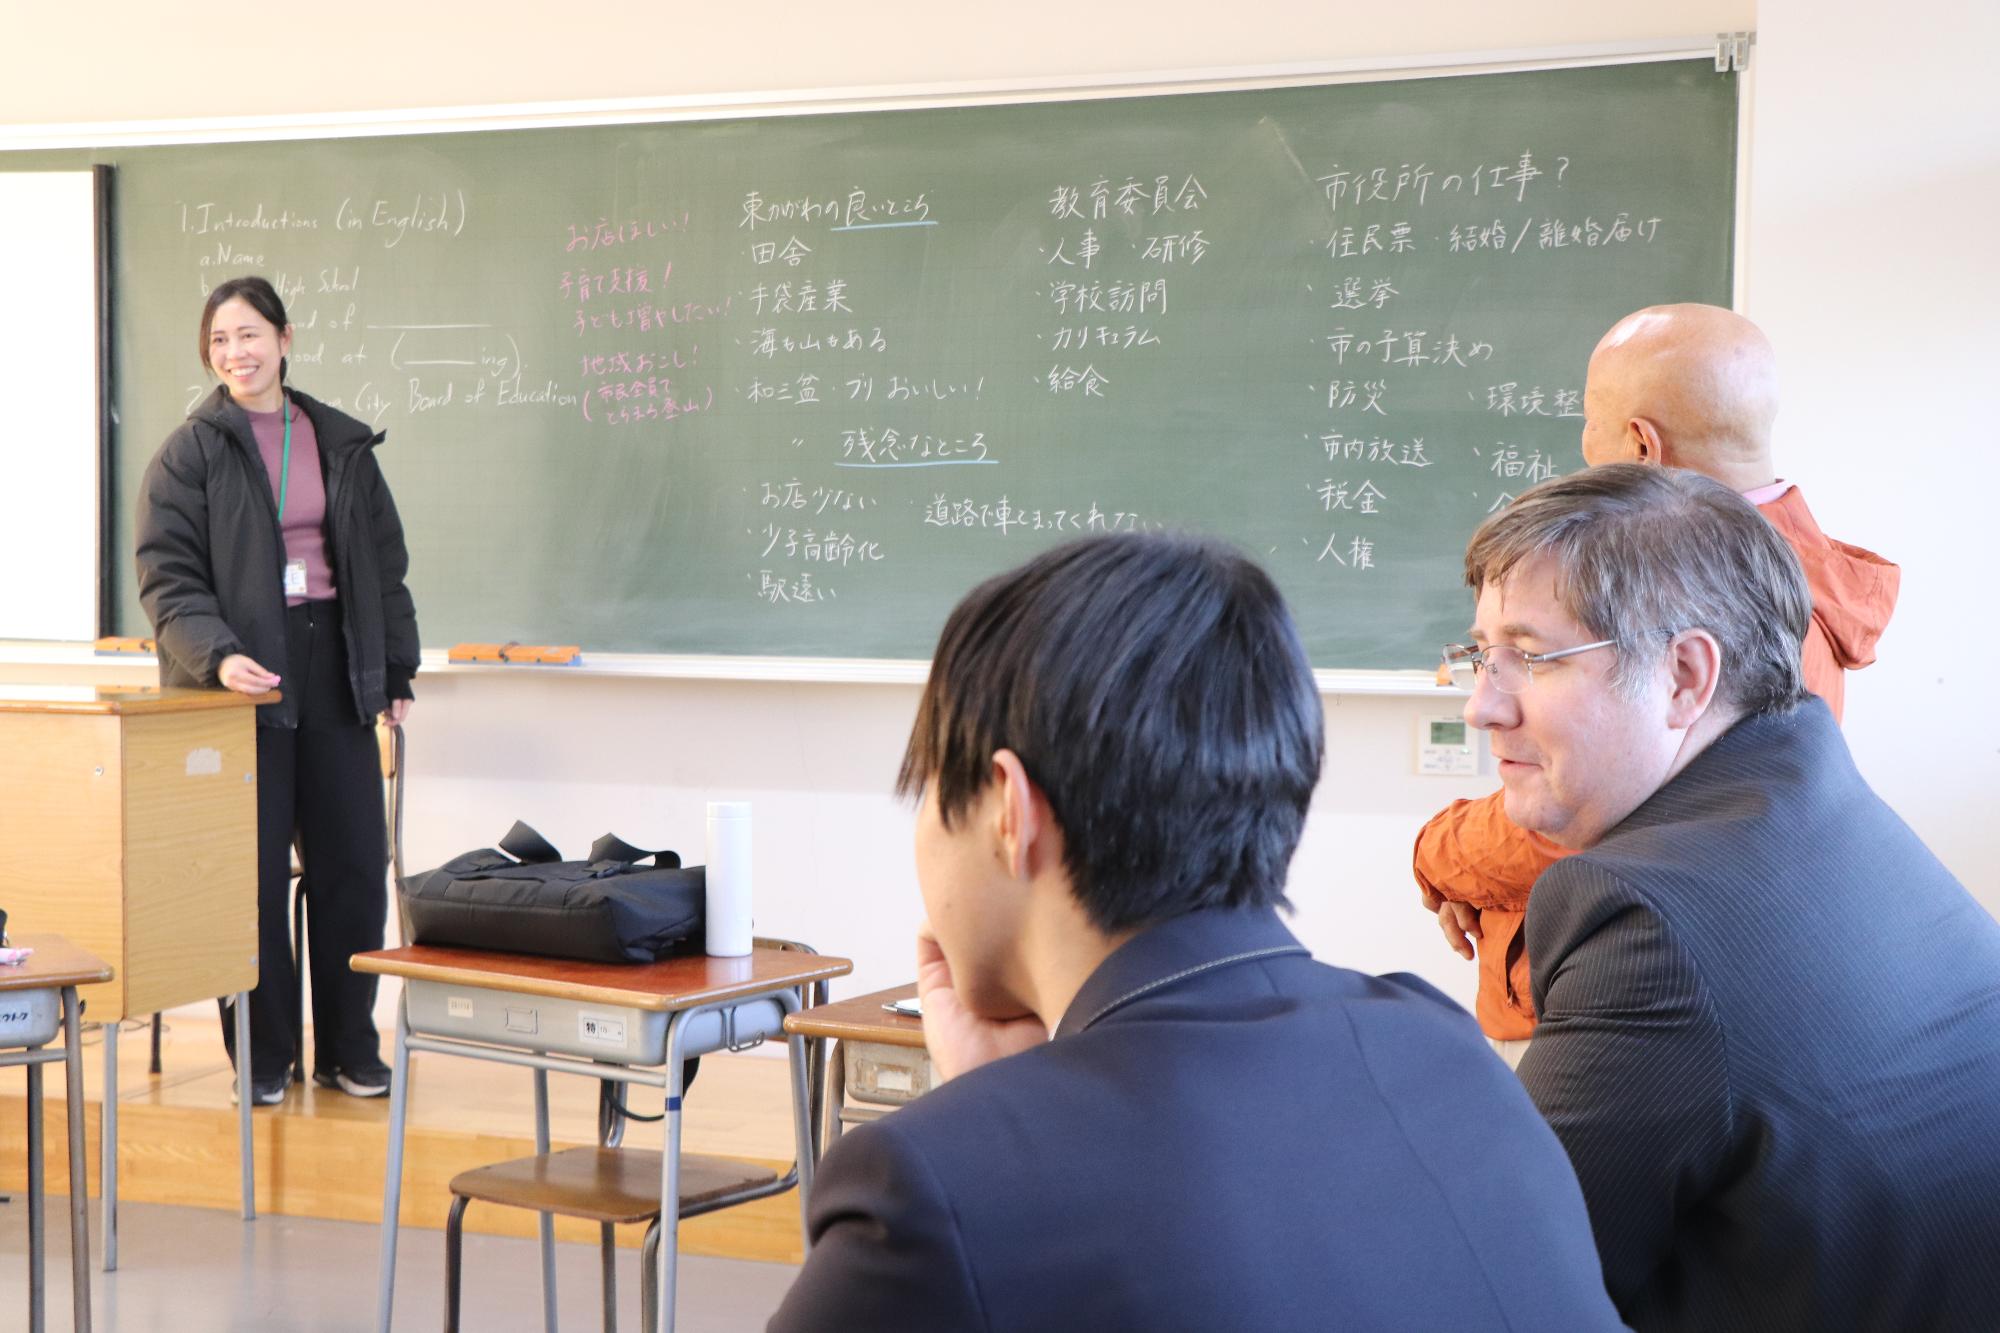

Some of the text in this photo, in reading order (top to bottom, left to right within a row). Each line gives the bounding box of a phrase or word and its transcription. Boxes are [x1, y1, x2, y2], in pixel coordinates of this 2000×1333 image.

[739, 186, 929, 231] 東かがわの良いところ
[1049, 174, 1208, 220] 教育委員会
[752, 235, 813, 266] 田舎
[1048, 227, 1210, 269] 人事 研修
[1326, 222, 1416, 258] 住民票
[751, 280, 853, 315] 手袋産業
[1050, 278, 1167, 314] 学校訪問
[1330, 276, 1399, 310] 選挙
[329, 303, 355, 331] of
[342, 344, 367, 365] at
[752, 328, 887, 359] 海も山もある
[1052, 325, 1161, 351] カリキュラム
[1327, 327, 1493, 367] 市の予算決め
[465, 377, 485, 403] of
[1048, 364, 1109, 397] 給食
[1328, 379, 1584, 417] 防災 環境整
[841, 427, 988, 462] 残念なところ
[1320, 429, 1561, 483] 市内放送 福祉
[761, 477, 877, 515] お店少ない
[1316, 479, 1387, 514] 税金
[761, 523, 885, 567] 少子高齢化
[1317, 532, 1376, 569] 人権
[757, 569, 837, 604] 駅遠い
